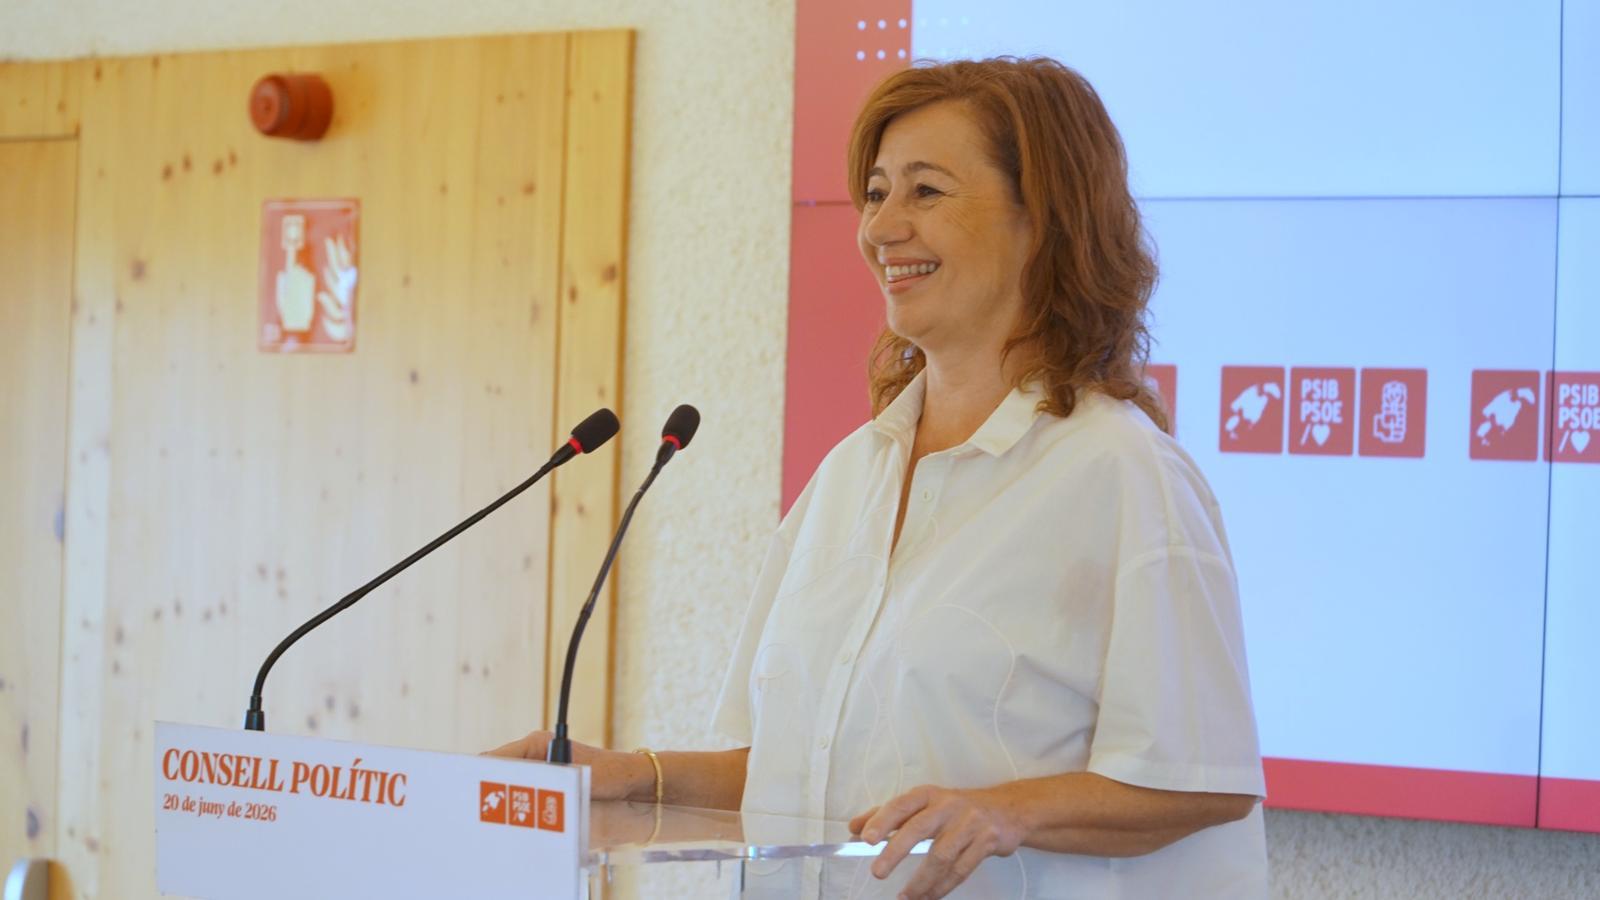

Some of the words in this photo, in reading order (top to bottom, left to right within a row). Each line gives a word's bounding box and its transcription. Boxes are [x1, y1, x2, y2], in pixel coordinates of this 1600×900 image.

[1301, 379, 1339, 401] PSIB
[1558, 383, 1599, 406] PSIB
[1300, 401, 1343, 424] PSOE
[1558, 406, 1600, 430] PSOE
[162, 748, 284, 792] CONSELL
[289, 758, 407, 807] POLÍTIC
[163, 792, 180, 811] 20
[181, 795, 197, 813] de
[197, 797, 225, 820] juny
[227, 801, 243, 818] de
[244, 803, 278, 823] 2026
